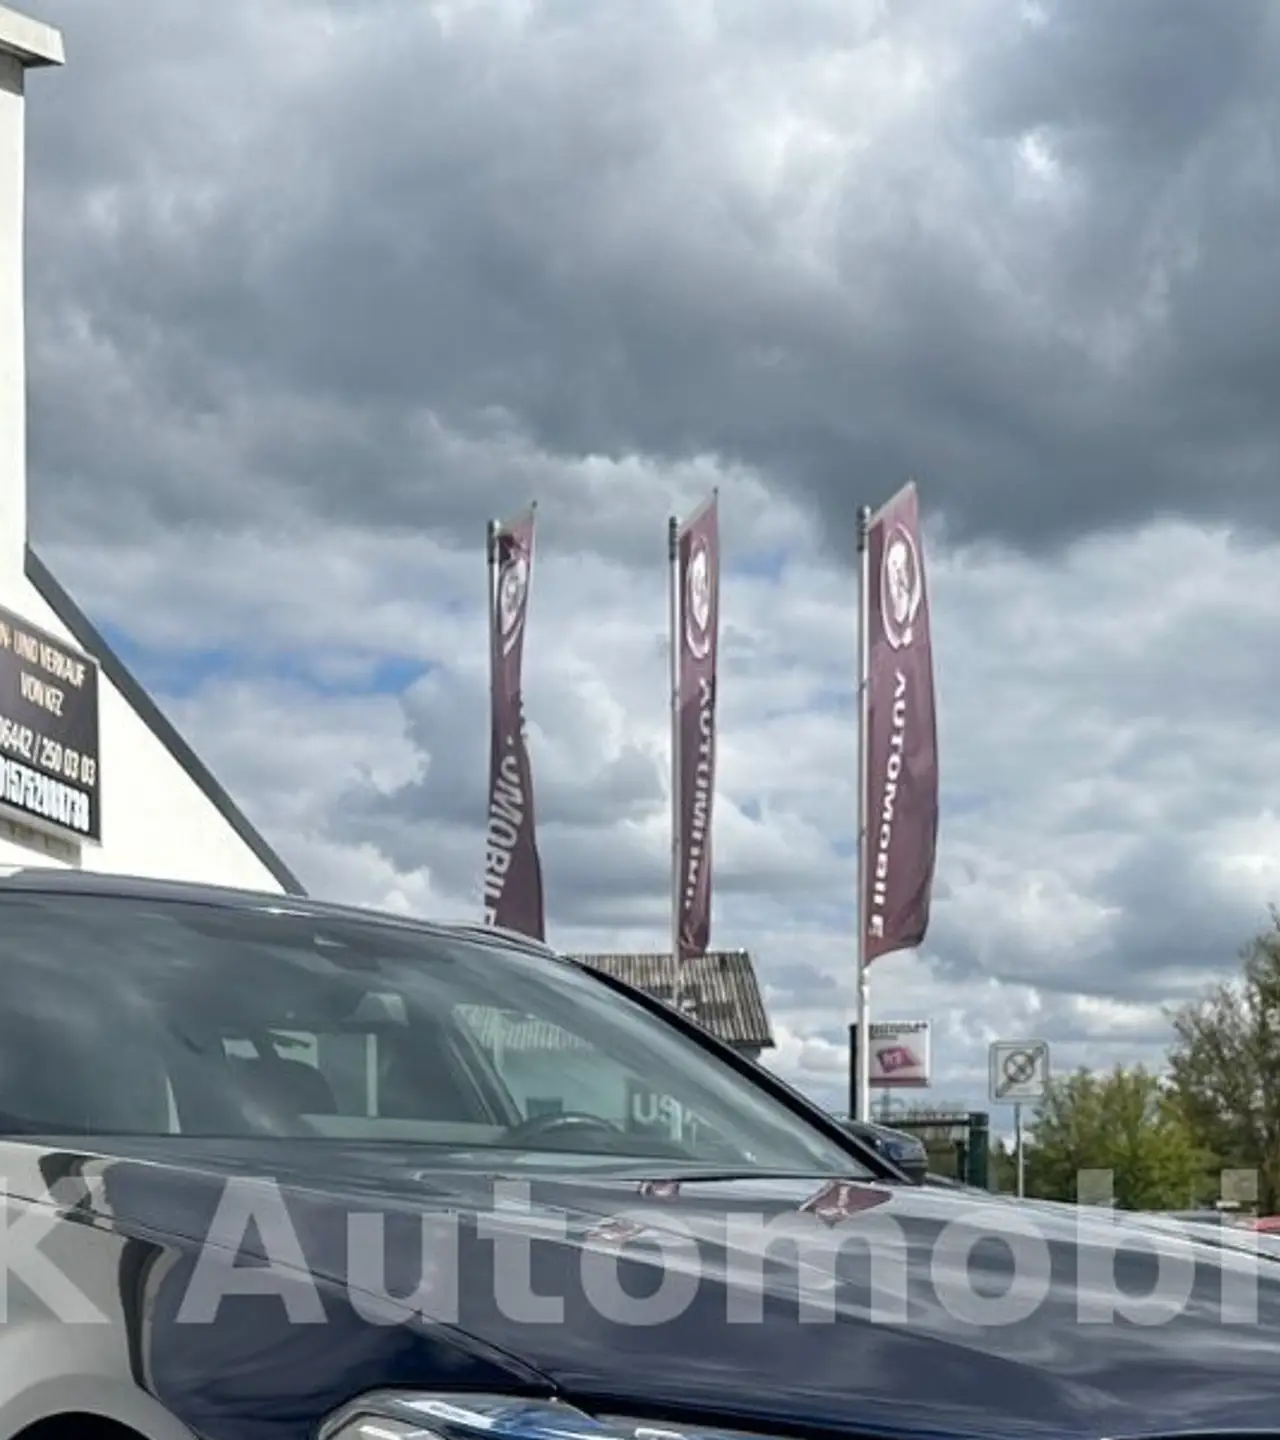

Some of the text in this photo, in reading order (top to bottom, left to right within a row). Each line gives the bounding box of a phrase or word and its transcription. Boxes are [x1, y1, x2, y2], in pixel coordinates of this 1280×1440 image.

[13, 629, 38, 665] UND
[40, 735, 62, 773] 250
[64, 748, 80, 780] 03
[81, 753, 97, 787] 03
